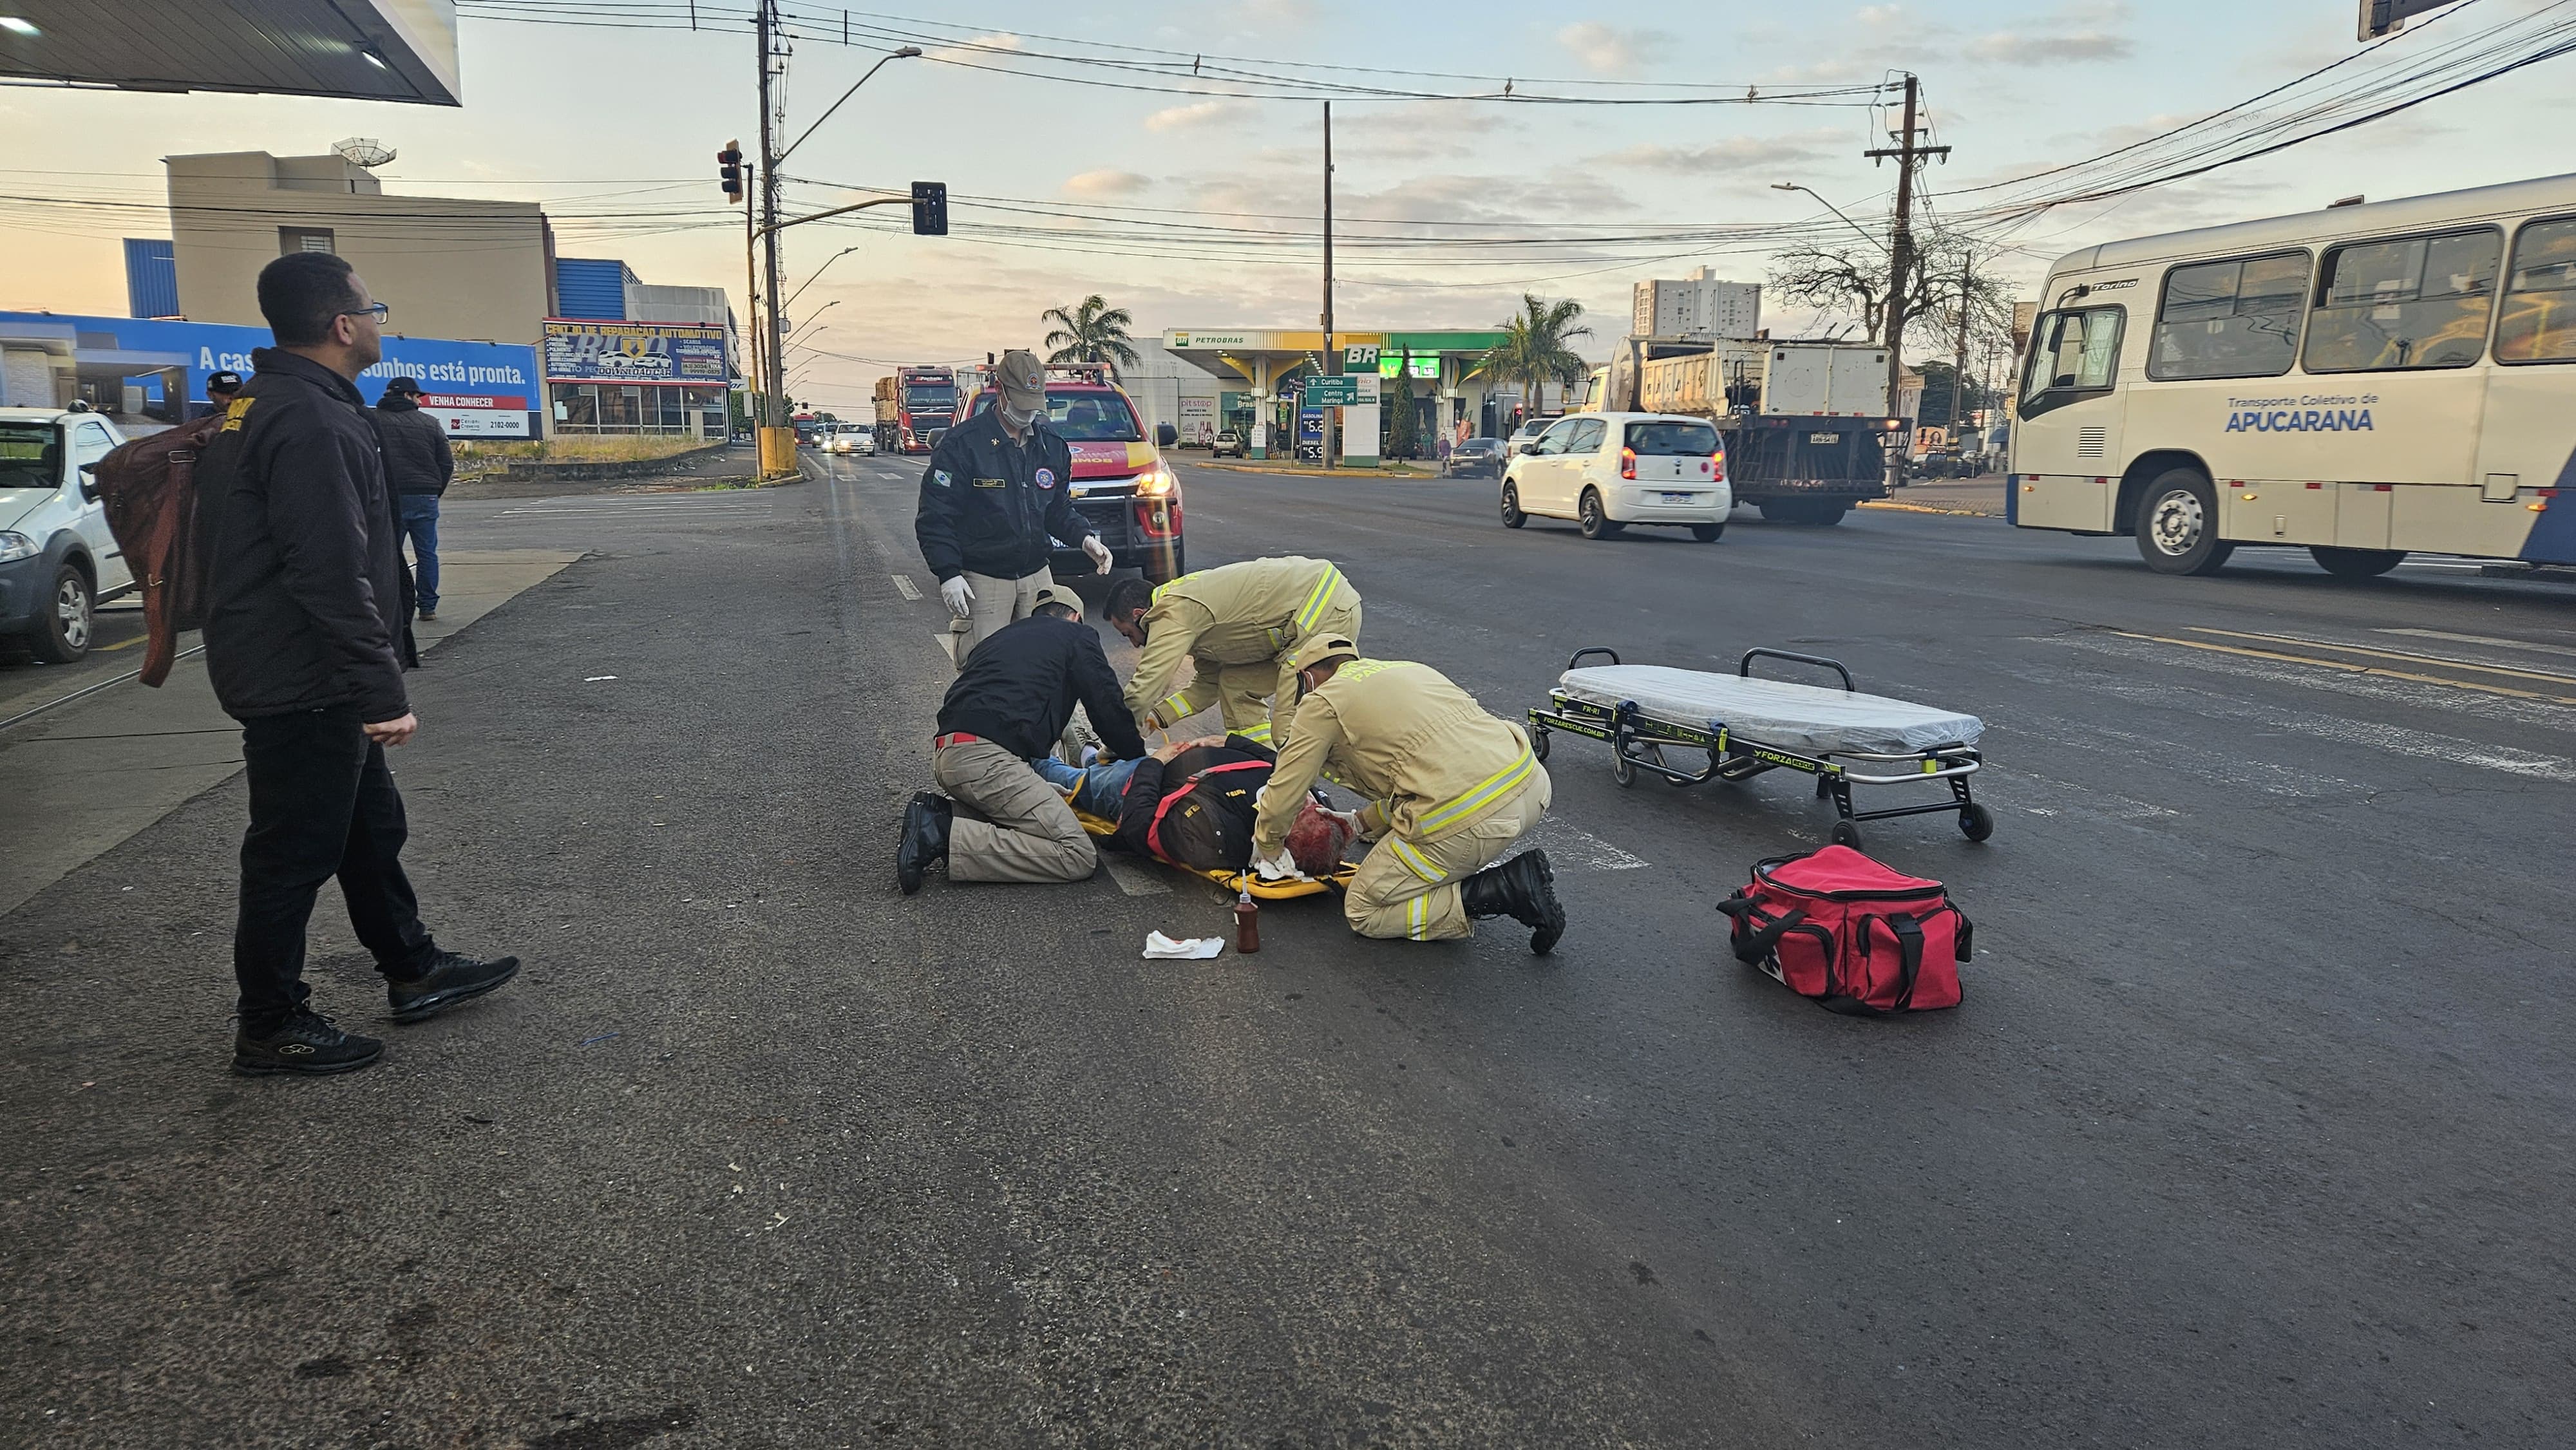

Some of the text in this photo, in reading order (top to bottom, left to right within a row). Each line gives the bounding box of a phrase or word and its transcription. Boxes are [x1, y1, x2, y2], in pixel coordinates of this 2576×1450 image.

[2094, 281, 2137, 290] Torino
[585, 326, 598, 334] DE
[659, 328, 722, 339] AUTOMOTIVO
[200, 346, 256, 372] A cas
[1347, 348, 1378, 364] BR
[430, 361, 466, 382] está
[469, 364, 526, 386] pronta.
[598, 366, 652, 377] DOWNLOAD
[429, 395, 494, 408] VENHA CONHECER
[1181, 399, 1191, 408] pit
[2228, 393, 2379, 409] Transporte Coletivo de
[1309, 420, 1323, 433] 6.2
[2225, 409, 2374, 432] APUCARANA
[1308, 446, 1323, 458] 5.9
[1543, 716, 1605, 738] FORZARESCUE.COM.BR
[1761, 751, 1815, 769] FORZA RESCUE
